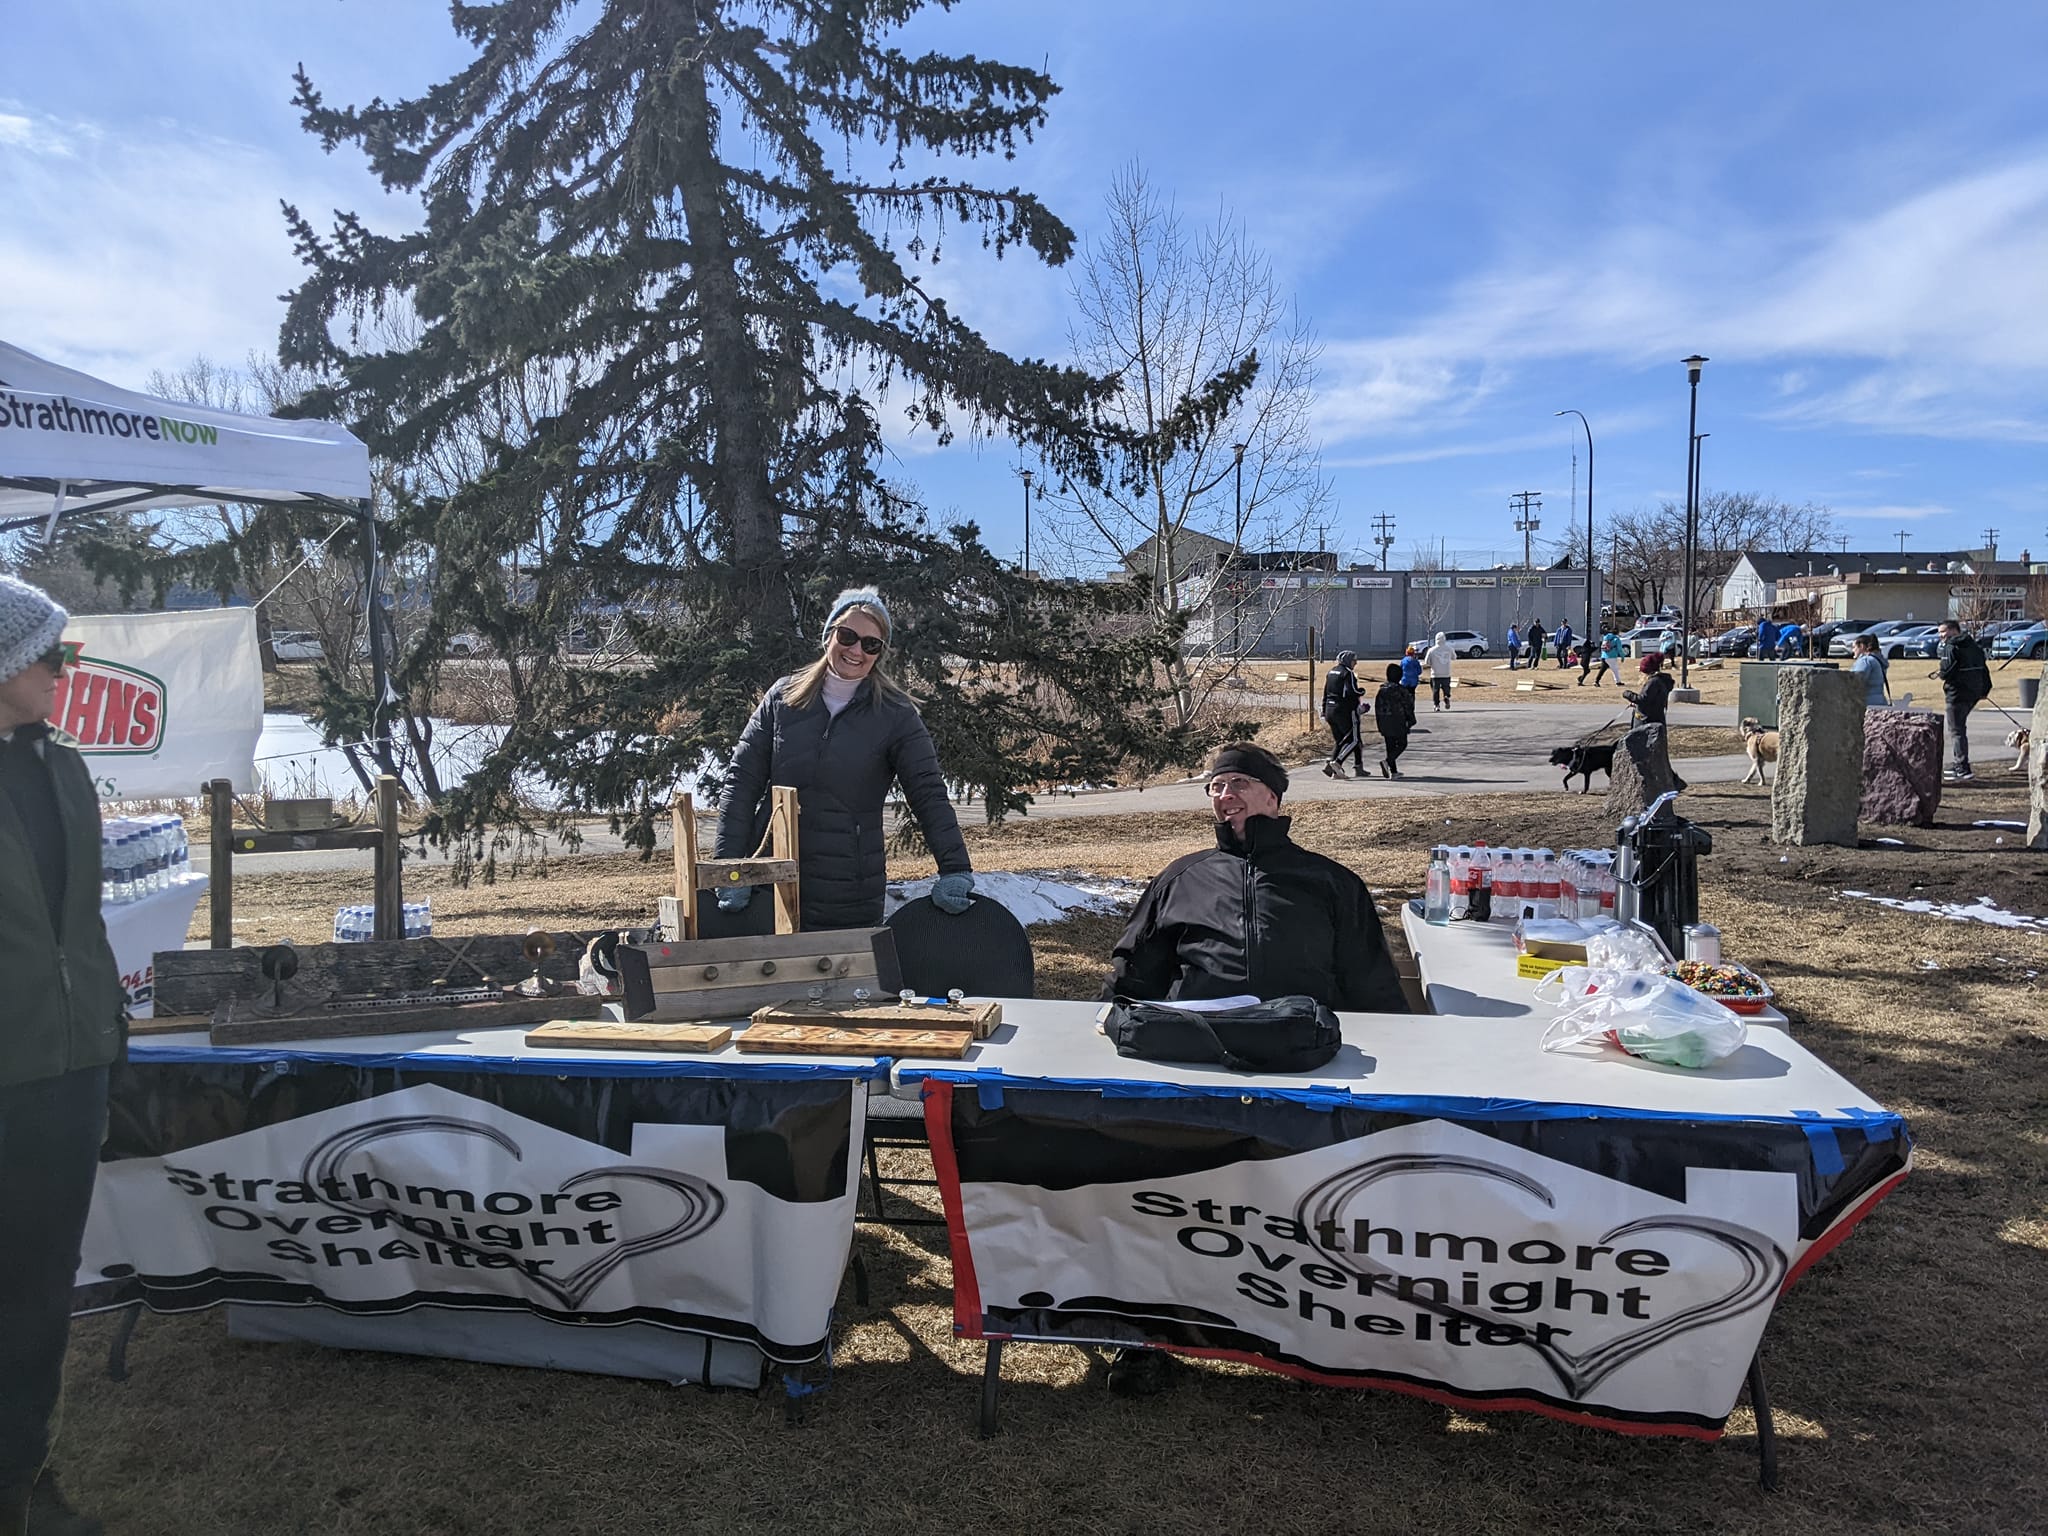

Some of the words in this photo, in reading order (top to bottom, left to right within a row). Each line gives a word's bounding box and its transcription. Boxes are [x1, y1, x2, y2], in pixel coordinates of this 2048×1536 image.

[163, 1164, 622, 1216] Strathmore
[203, 1205, 616, 1250] Overnight
[266, 1238, 554, 1275] Shelter
[1130, 1190, 1671, 1277] Strathmore
[1176, 1226, 1651, 1320] Overnight
[1235, 1271, 1573, 1347] Shelter
